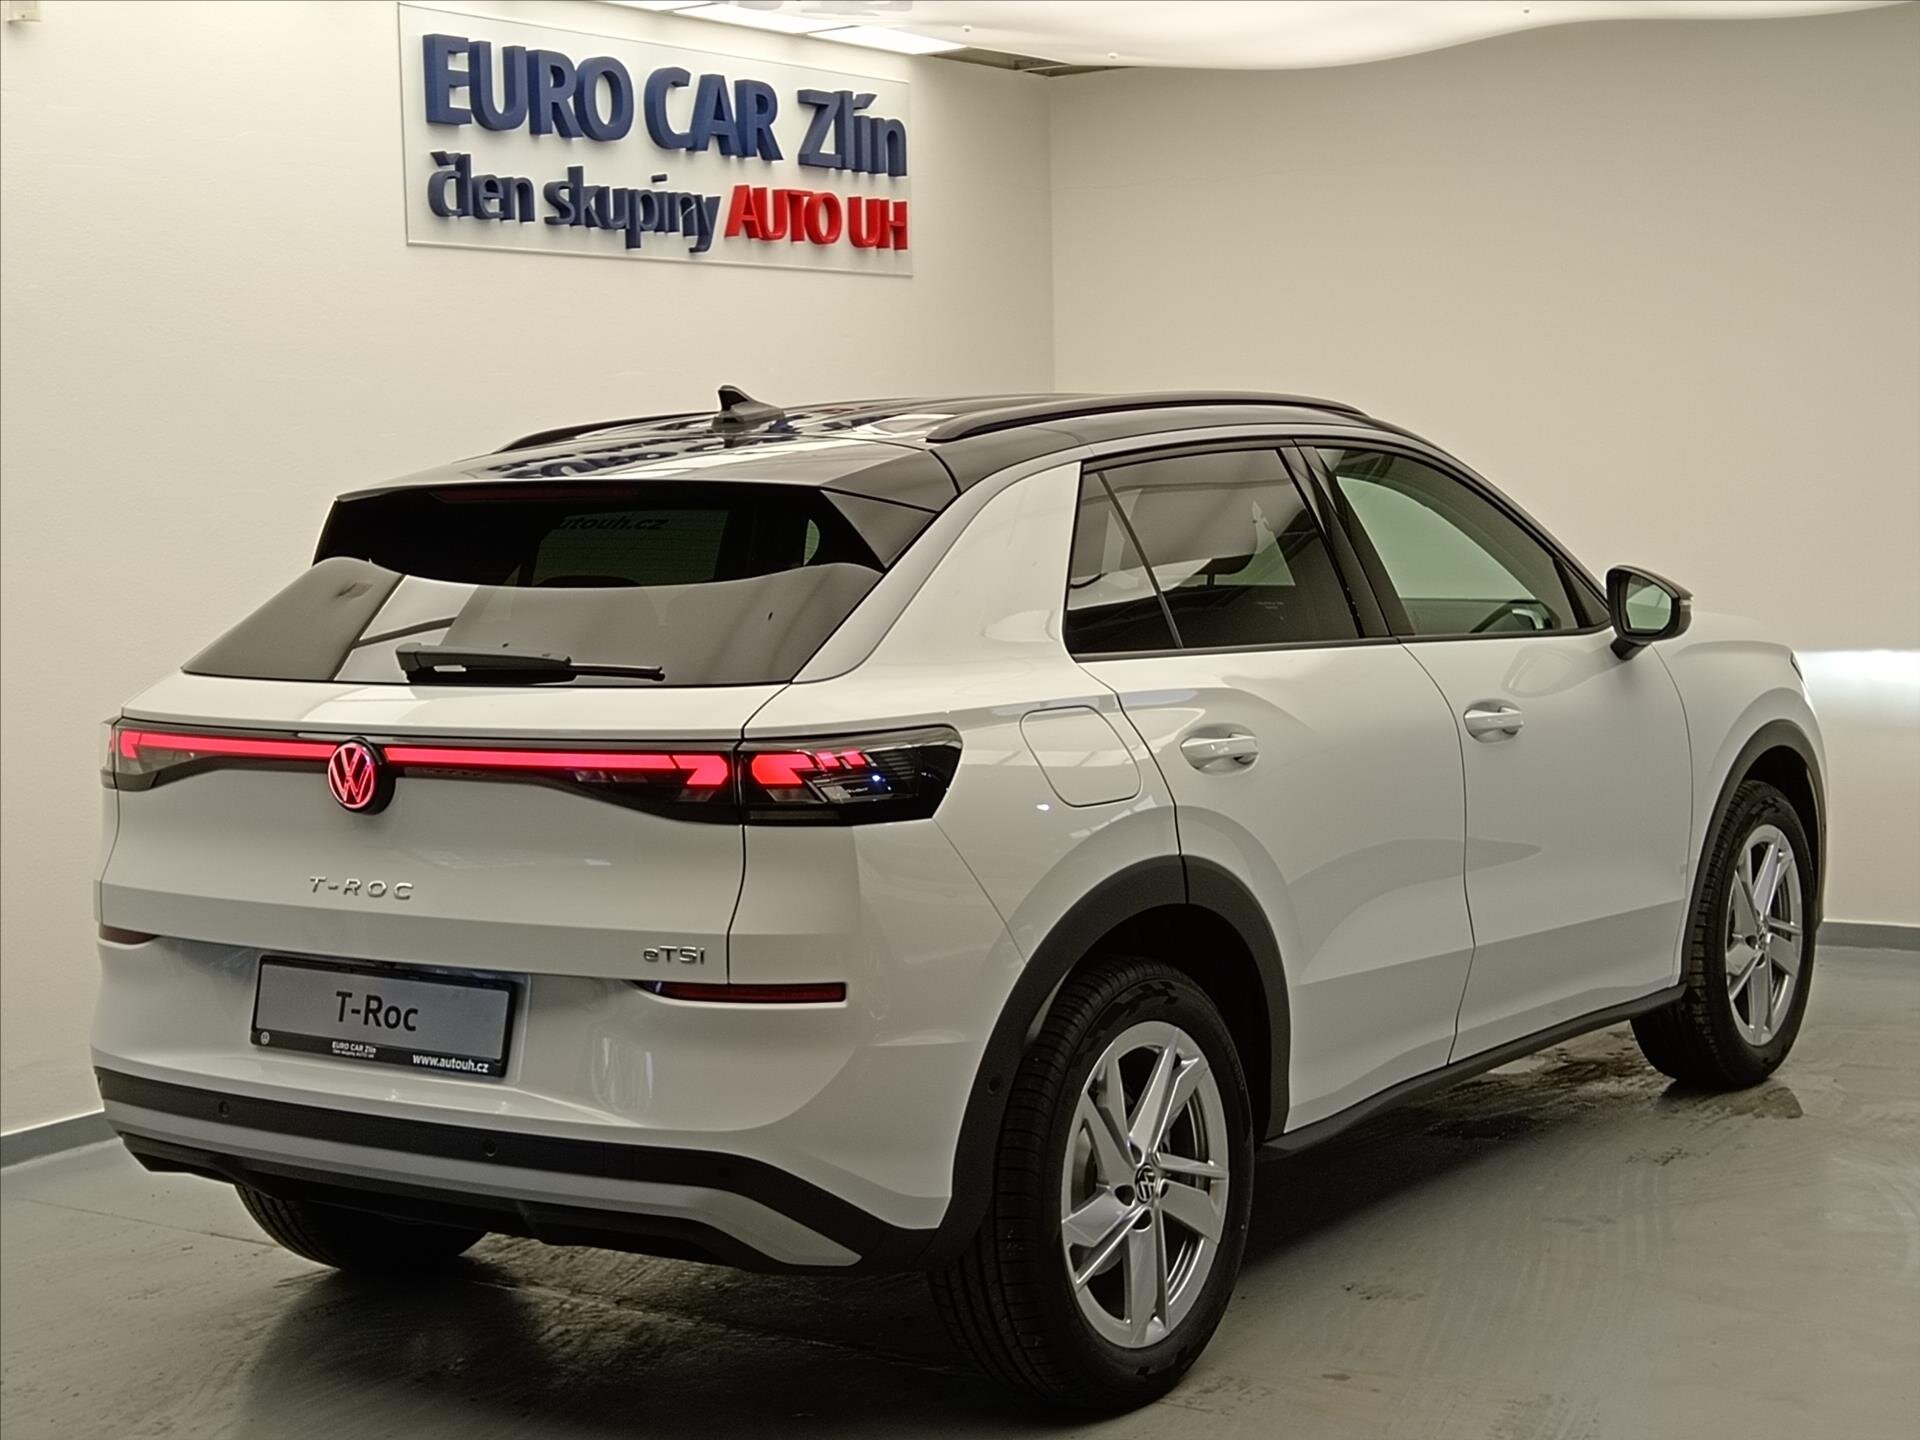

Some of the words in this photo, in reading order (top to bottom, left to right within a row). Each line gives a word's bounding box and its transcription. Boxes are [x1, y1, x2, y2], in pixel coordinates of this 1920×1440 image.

[423, 34, 634, 141] EURO
[644, 67, 784, 160] CAR
[797, 89, 907, 177] Zlín
[428, 151, 535, 222] člen
[544, 165, 721, 253] skupiny
[724, 185, 842, 244] AUTO
[848, 196, 908, 250] UH
[558, 515, 670, 530] utouh.cz
[309, 876, 414, 900] T-ROC
[336, 990, 419, 1032] T-Roc
[412, 1054, 489, 1073] www.autouh.cz
